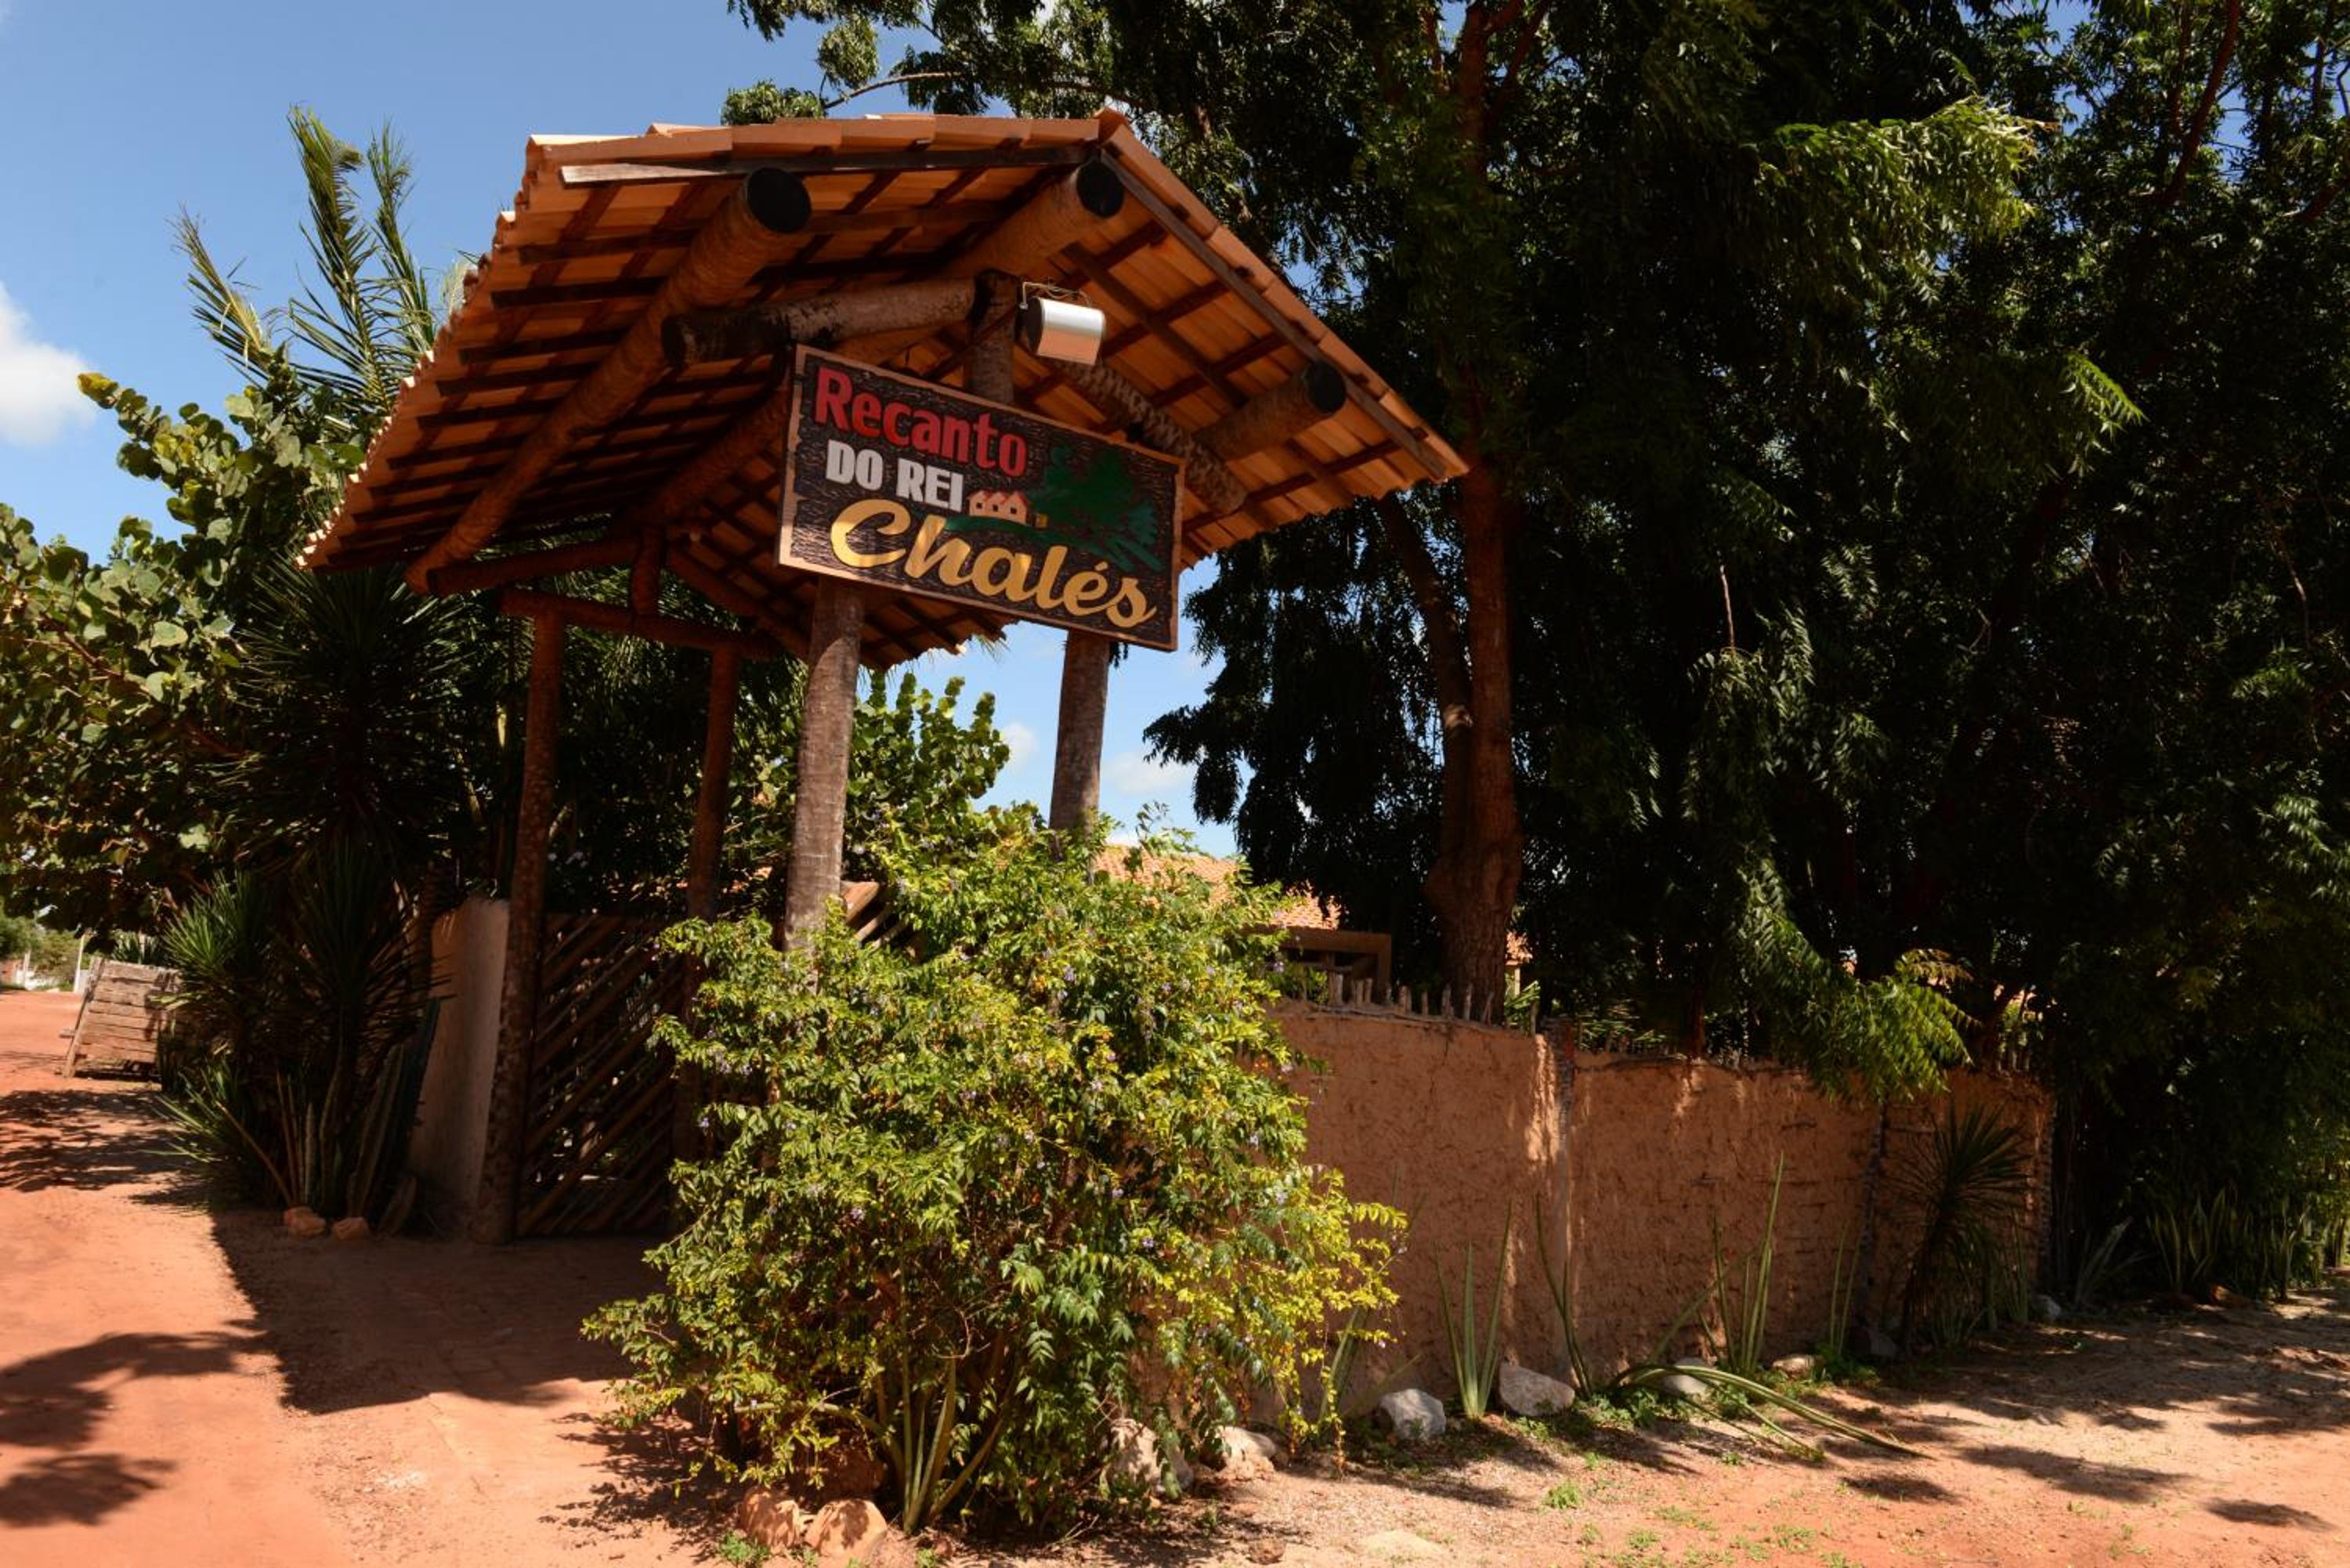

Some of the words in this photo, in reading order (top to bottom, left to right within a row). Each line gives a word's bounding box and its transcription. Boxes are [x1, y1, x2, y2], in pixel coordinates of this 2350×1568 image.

[814, 366, 1028, 477] Recanto
[826, 439, 884, 490] DO
[896, 457, 964, 512] REI
[830, 497, 1157, 628] Chalés
